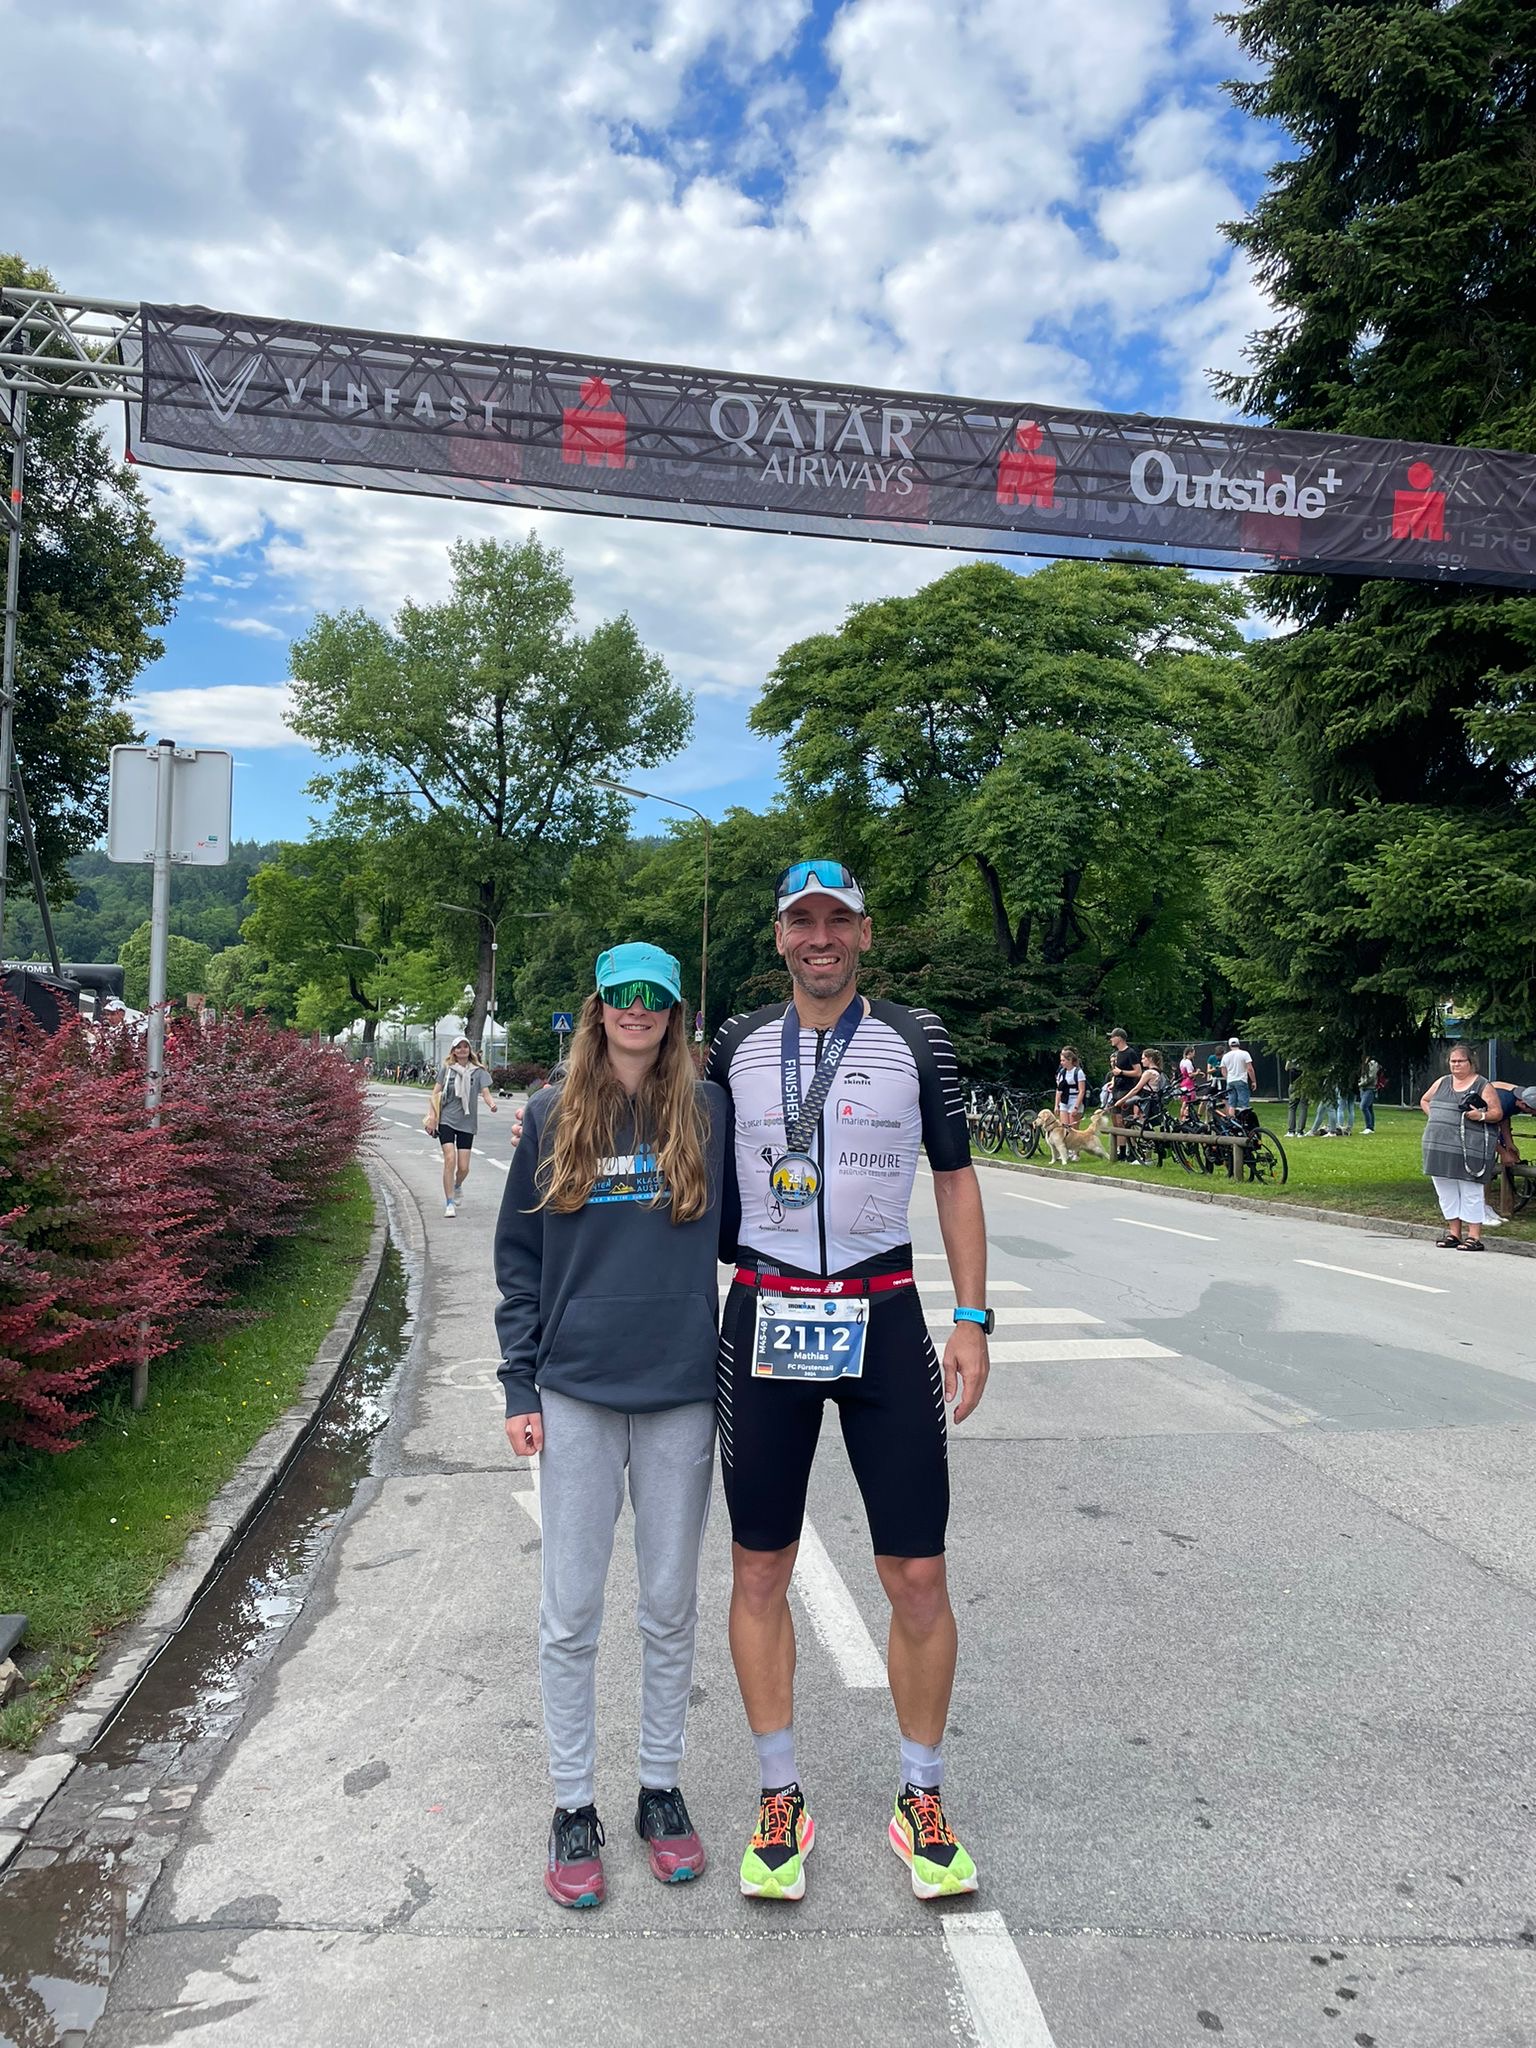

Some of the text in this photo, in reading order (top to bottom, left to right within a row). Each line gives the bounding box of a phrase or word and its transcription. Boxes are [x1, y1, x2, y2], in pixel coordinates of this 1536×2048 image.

[285, 377, 500, 427] VINFAST
[709, 395, 915, 461] QATAR
[759, 453, 914, 496] AIRWAYS
[824, 1038, 846, 1067] 2024
[784, 1059, 800, 1122] FINISHER
[841, 1118, 870, 1127] marien
[838, 1151, 902, 1168] APOPURE
[758, 1320, 768, 1354] M45-49
[773, 1324, 850, 1352] 2112
[793, 1352, 830, 1361] Mathias
[797, 1363, 834, 1372] Fürstenzell
